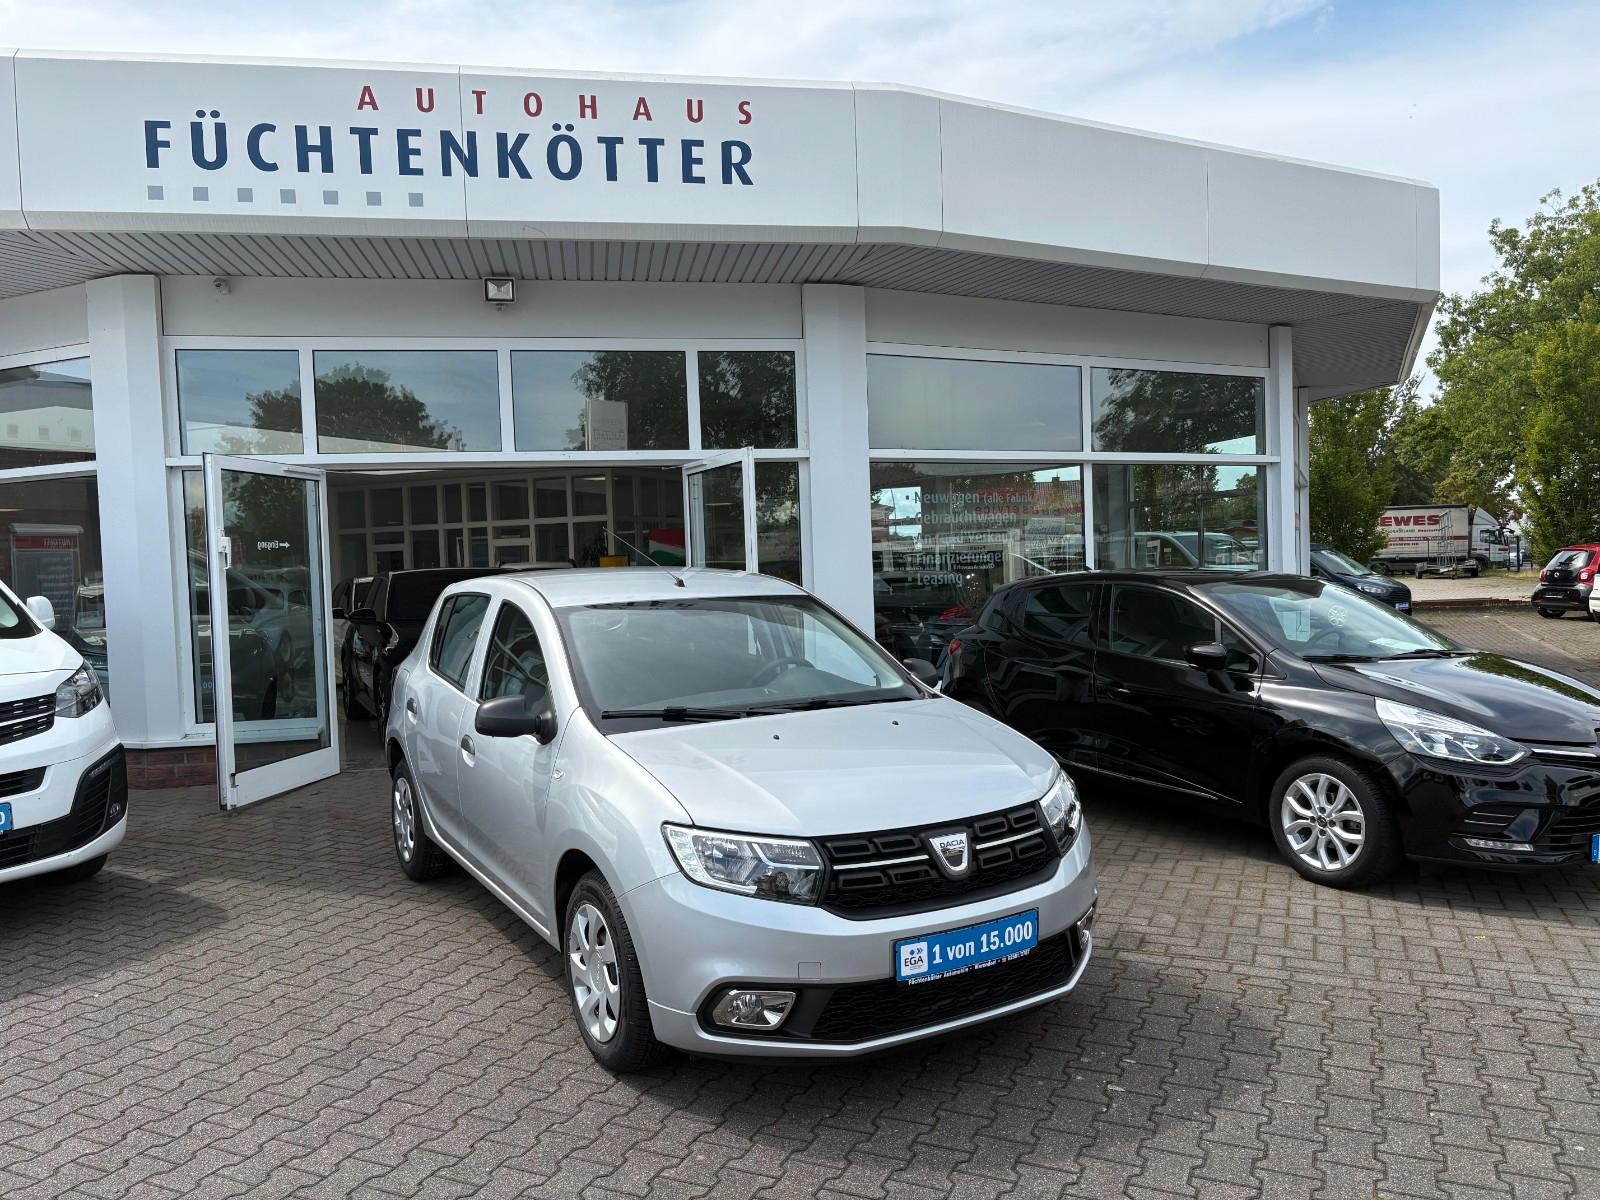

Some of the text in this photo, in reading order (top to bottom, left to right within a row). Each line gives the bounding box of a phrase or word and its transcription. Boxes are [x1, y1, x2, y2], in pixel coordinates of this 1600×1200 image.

[357, 84, 754, 126] AUTOHAUS
[144, 108, 755, 186] FÜCHTENKÖTTER
[914, 490, 979, 507] Neuwagen
[917, 572, 963, 587] Leasing
[940, 839, 965, 848] DACIA
[932, 921, 1033, 964] 1 von 15.000
[904, 956, 924, 967] EGA
